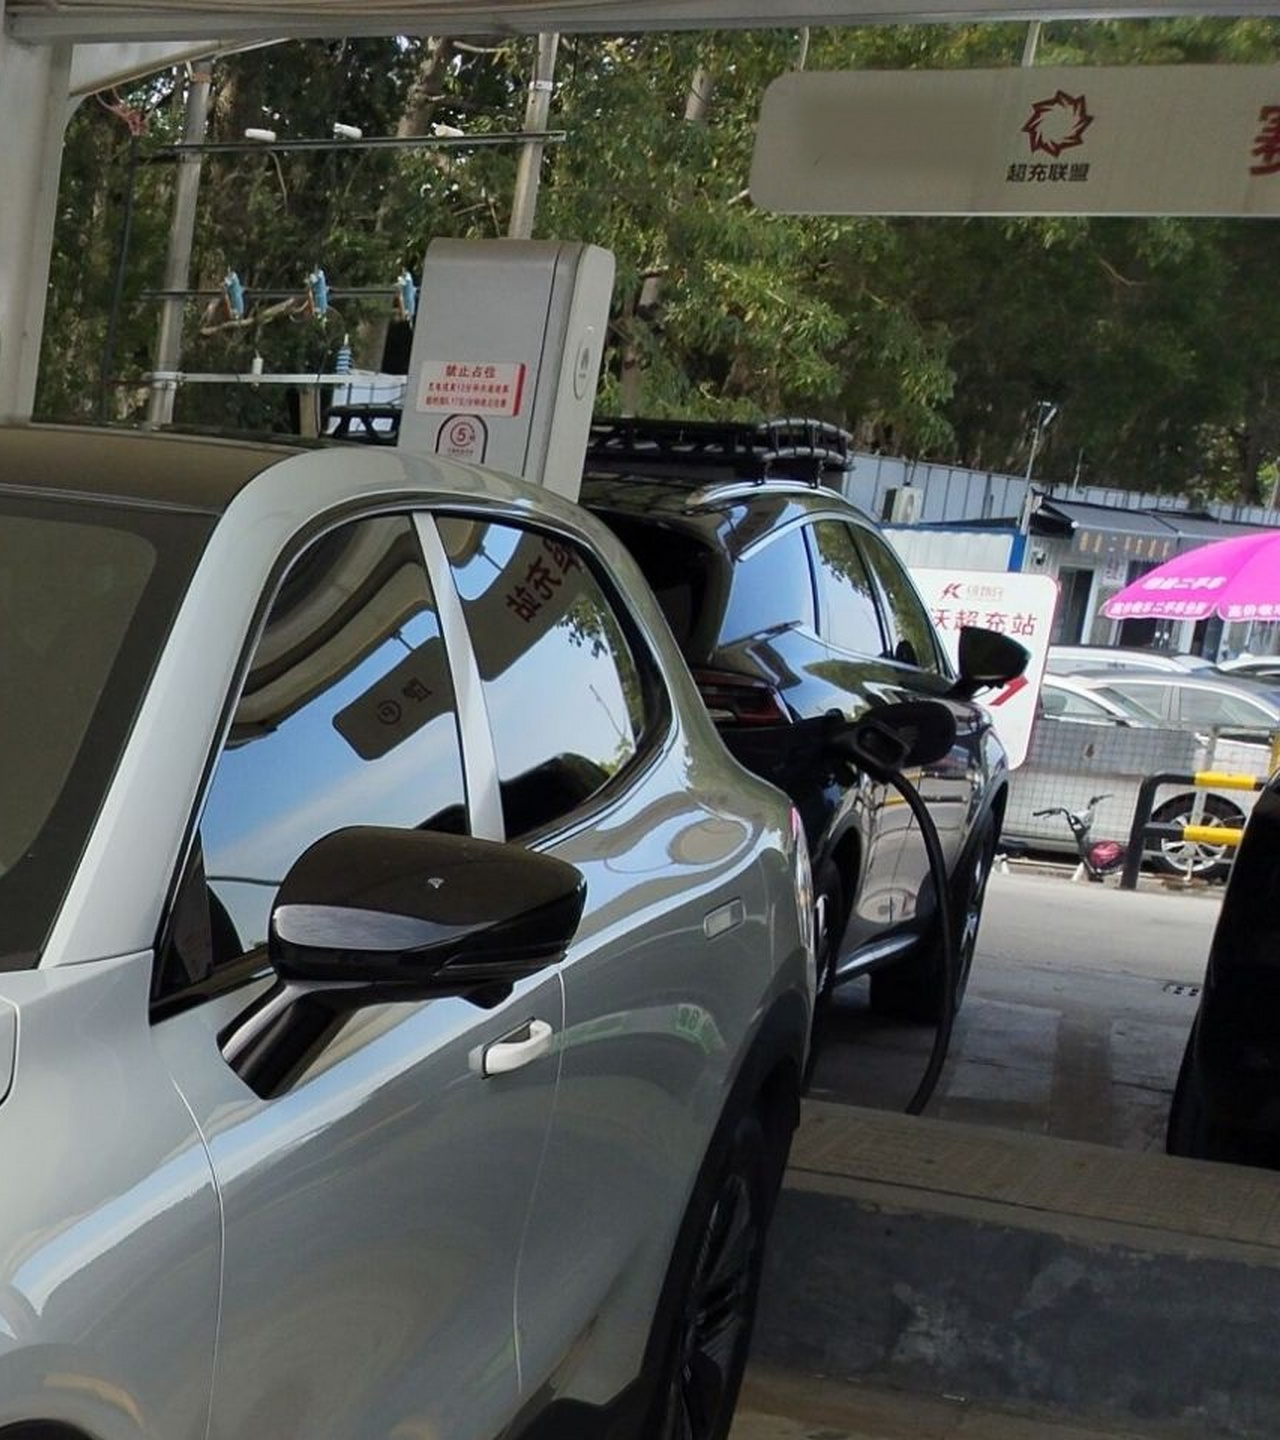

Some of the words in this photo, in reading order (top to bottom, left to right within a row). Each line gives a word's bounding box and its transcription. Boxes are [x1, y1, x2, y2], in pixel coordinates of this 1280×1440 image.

[1005, 163, 1090, 182] 超充联盟
[446, 364, 496, 379] 禁止占位
